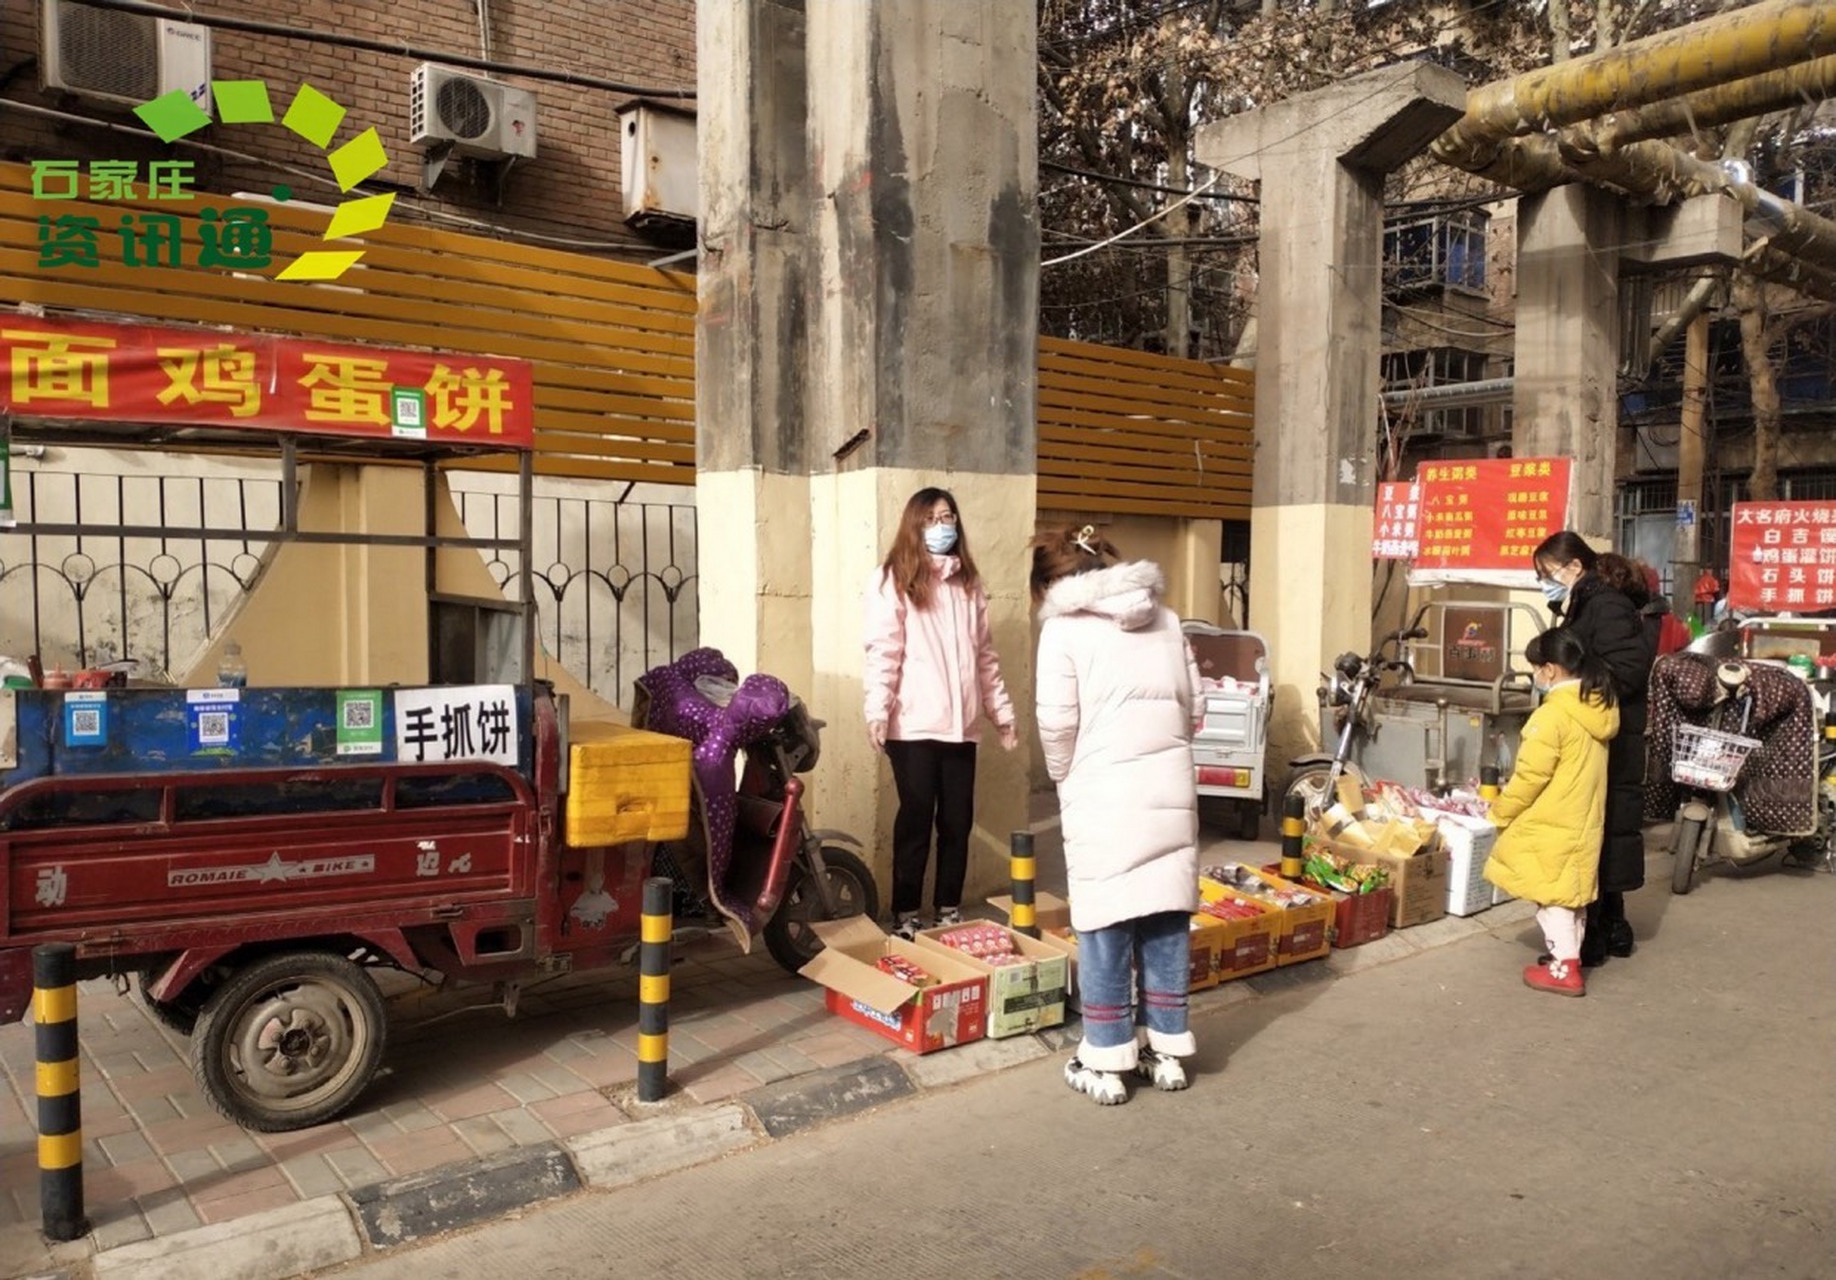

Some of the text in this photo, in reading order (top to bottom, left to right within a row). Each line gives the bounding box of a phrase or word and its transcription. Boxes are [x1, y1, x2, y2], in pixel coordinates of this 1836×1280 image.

[2, 330, 513, 434] 面鸡蛋饼
[1509, 461, 1551, 477] 豆浆类
[1431, 493, 1469, 506] 八宝粥
[1382, 503, 1417, 520] 八宝粥
[1379, 521, 1415, 538] 小米粥
[1762, 547, 1836, 564] 鸡蛋灌饼
[1762, 567, 1834, 585] 石头饼
[1760, 587, 1834, 604] 手抓饼
[404, 700, 511, 762] 手抓饼
[171, 860, 356, 885] ROMAIE BIKE
